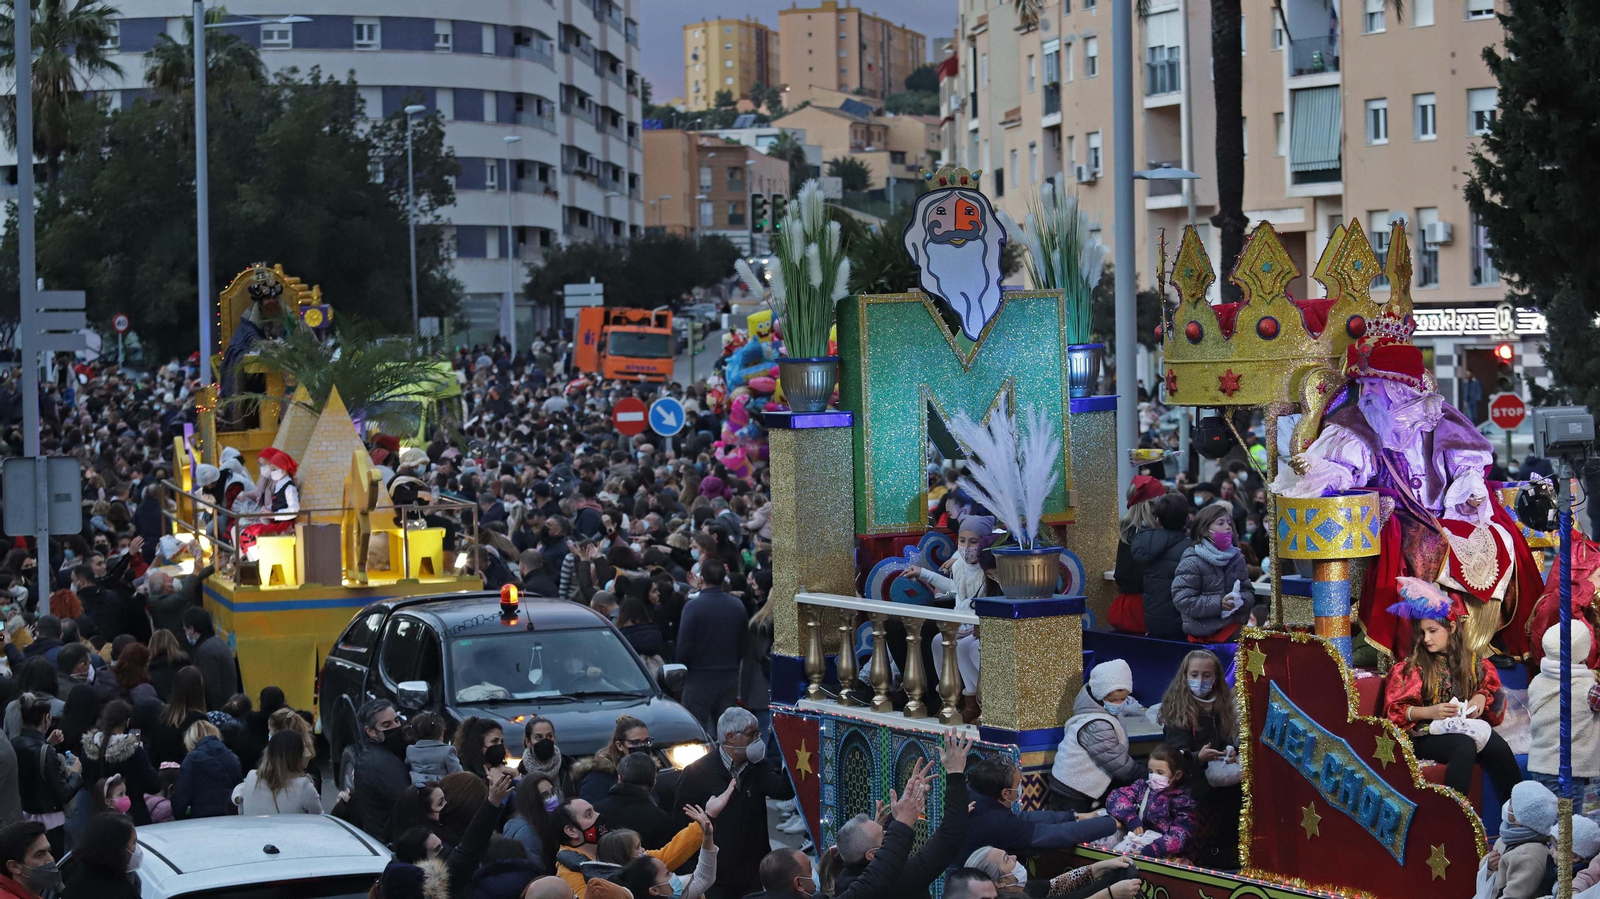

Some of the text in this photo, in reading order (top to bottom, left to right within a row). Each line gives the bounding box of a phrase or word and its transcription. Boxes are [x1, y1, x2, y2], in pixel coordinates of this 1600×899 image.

[1413, 308, 1480, 336] rooklyn
[1492, 407, 1524, 418] STOP
[1266, 702, 1401, 846] MELCHOR
